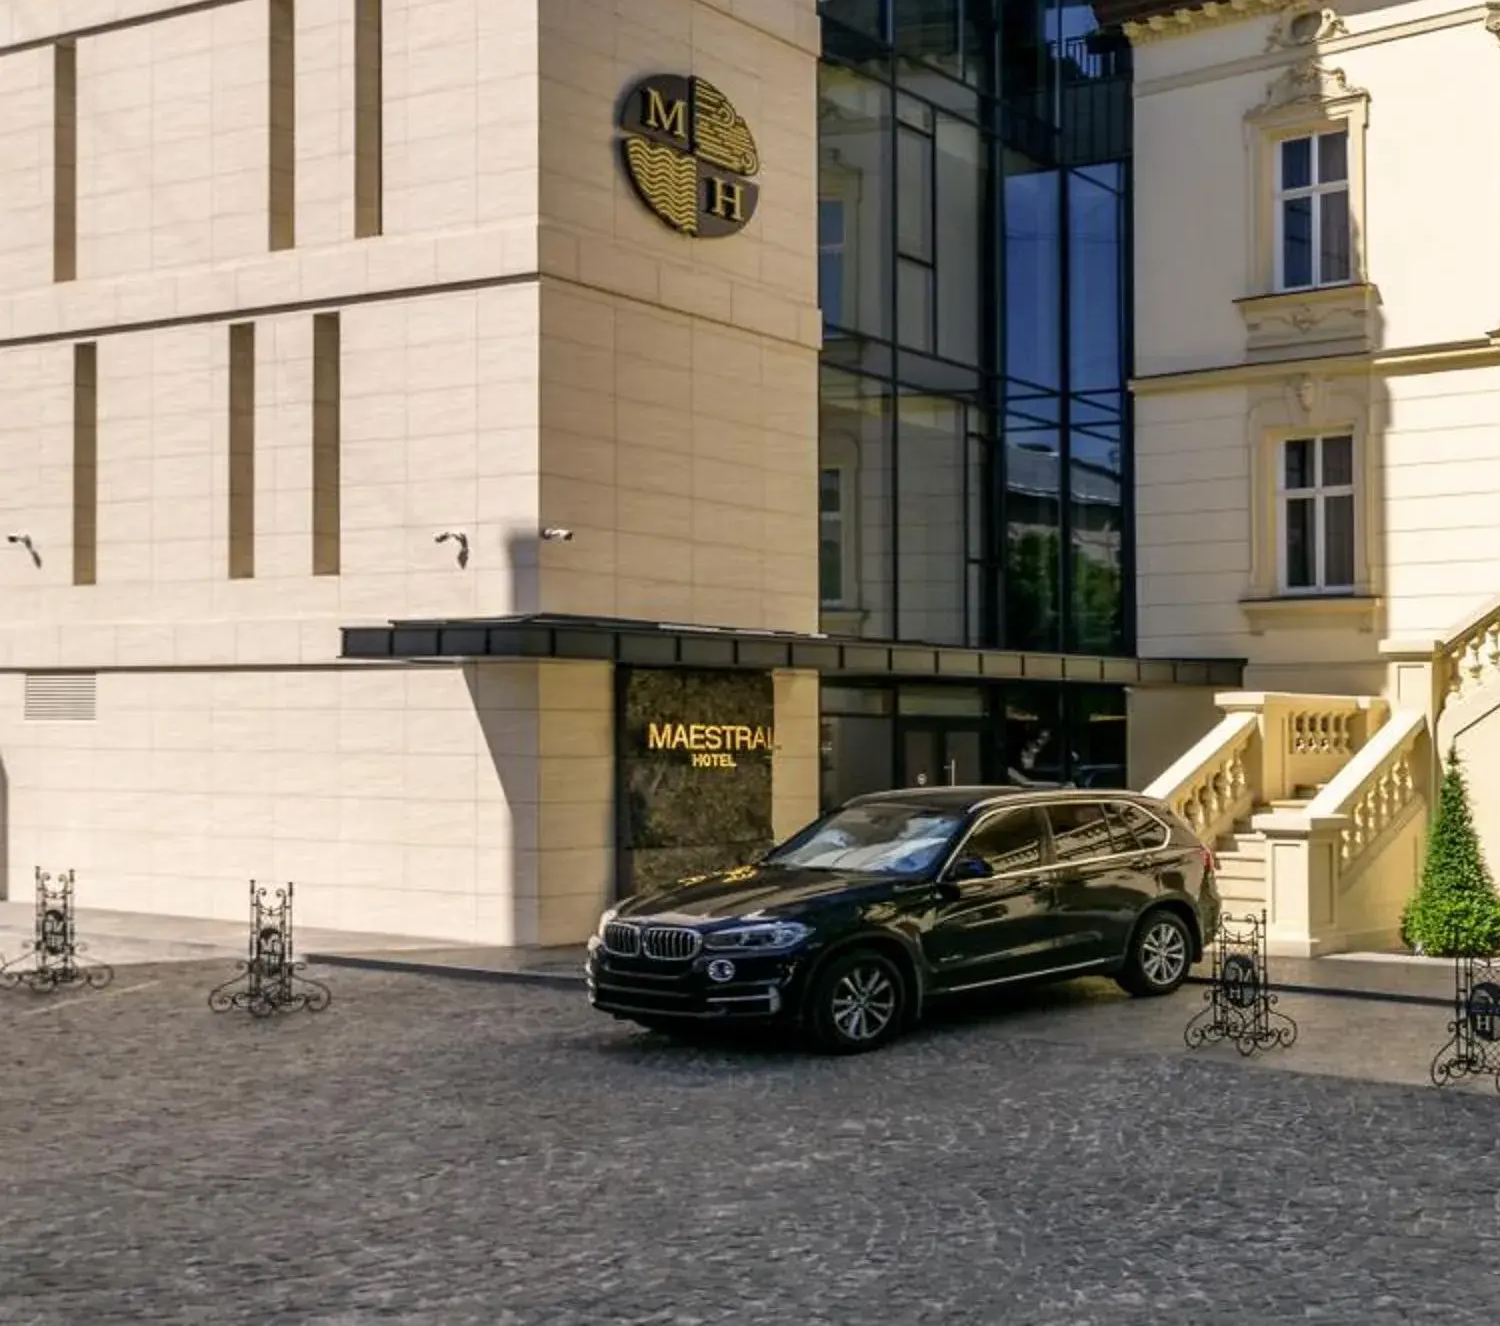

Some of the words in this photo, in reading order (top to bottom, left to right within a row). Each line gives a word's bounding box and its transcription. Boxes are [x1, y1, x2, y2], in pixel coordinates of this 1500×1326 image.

[645, 85, 688, 139] M
[710, 176, 745, 222] H
[648, 722, 782, 750] MAESTRAL
[691, 753, 737, 767] HOTEL
